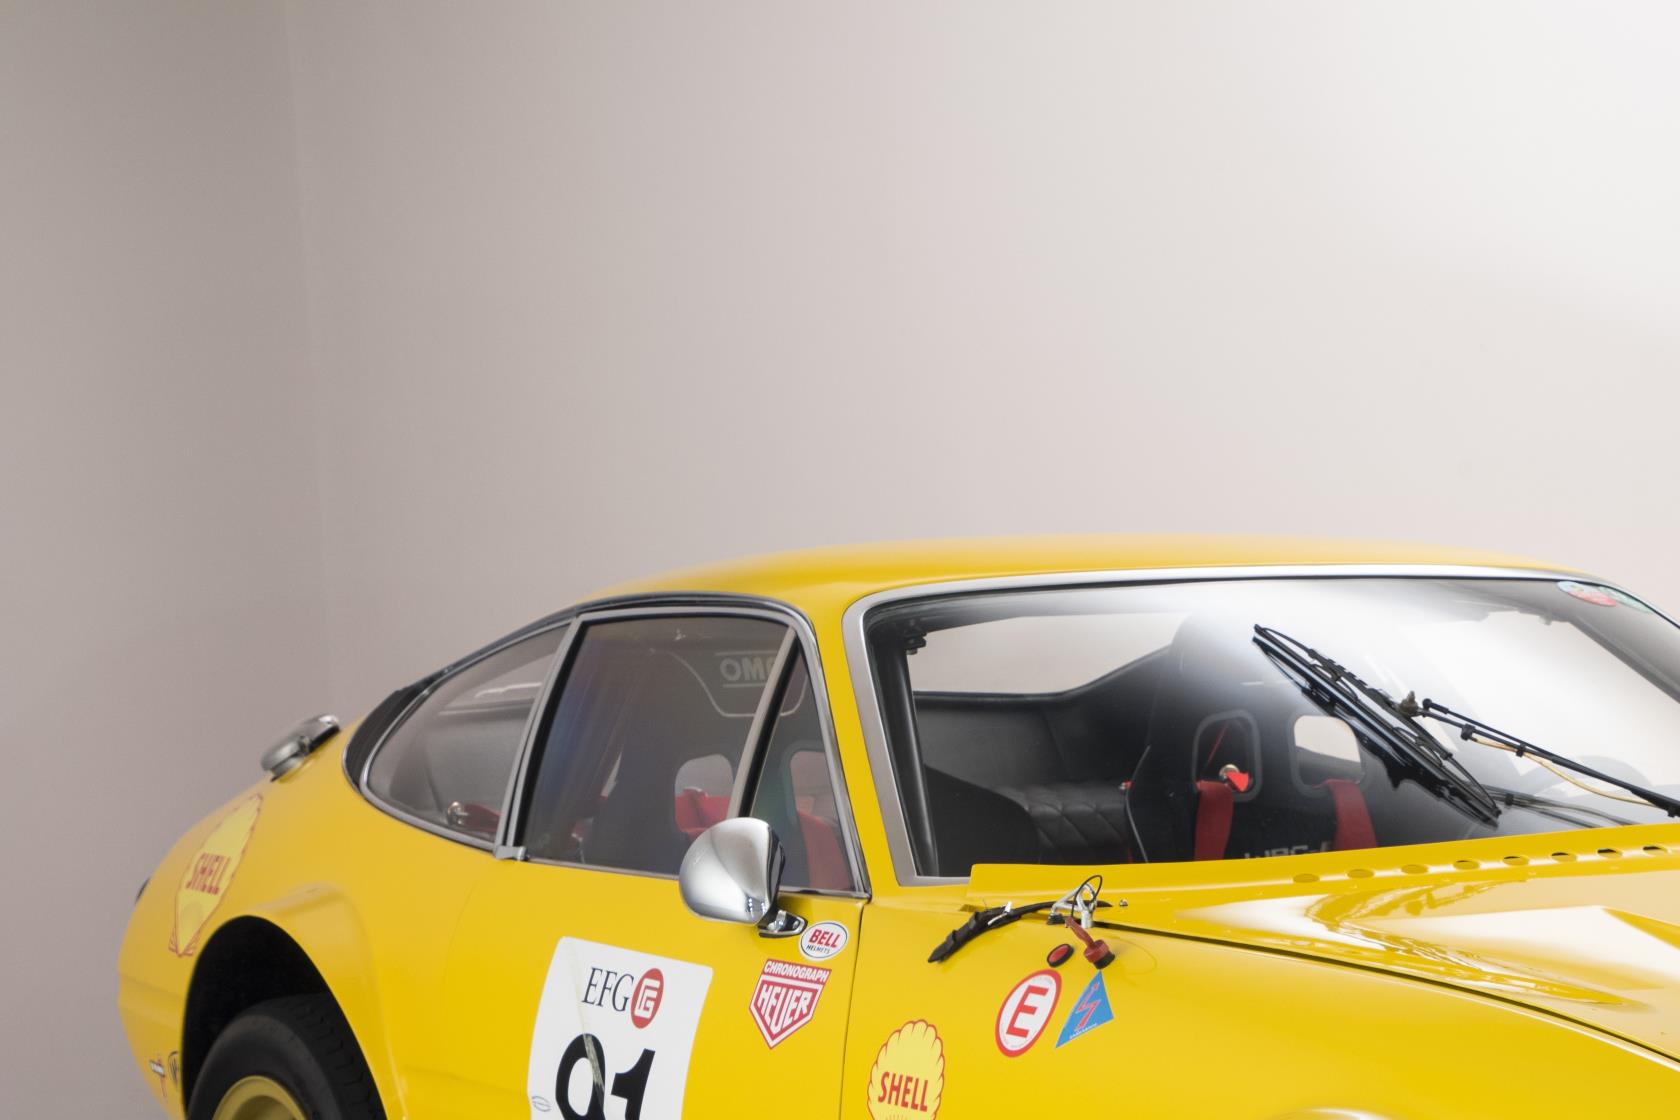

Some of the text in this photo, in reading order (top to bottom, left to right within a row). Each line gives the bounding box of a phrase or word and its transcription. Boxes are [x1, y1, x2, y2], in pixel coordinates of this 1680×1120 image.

[186, 853, 231, 895] SHELL
[805, 944, 831, 955] HELMETS
[808, 929, 841, 949] BELL
[581, 966, 635, 1012] EFG
[764, 960, 830, 983] CHRONOGRAPH
[756, 983, 813, 1035] HEUER
[1006, 984, 1050, 1039] E
[877, 1071, 929, 1113] SHELL
